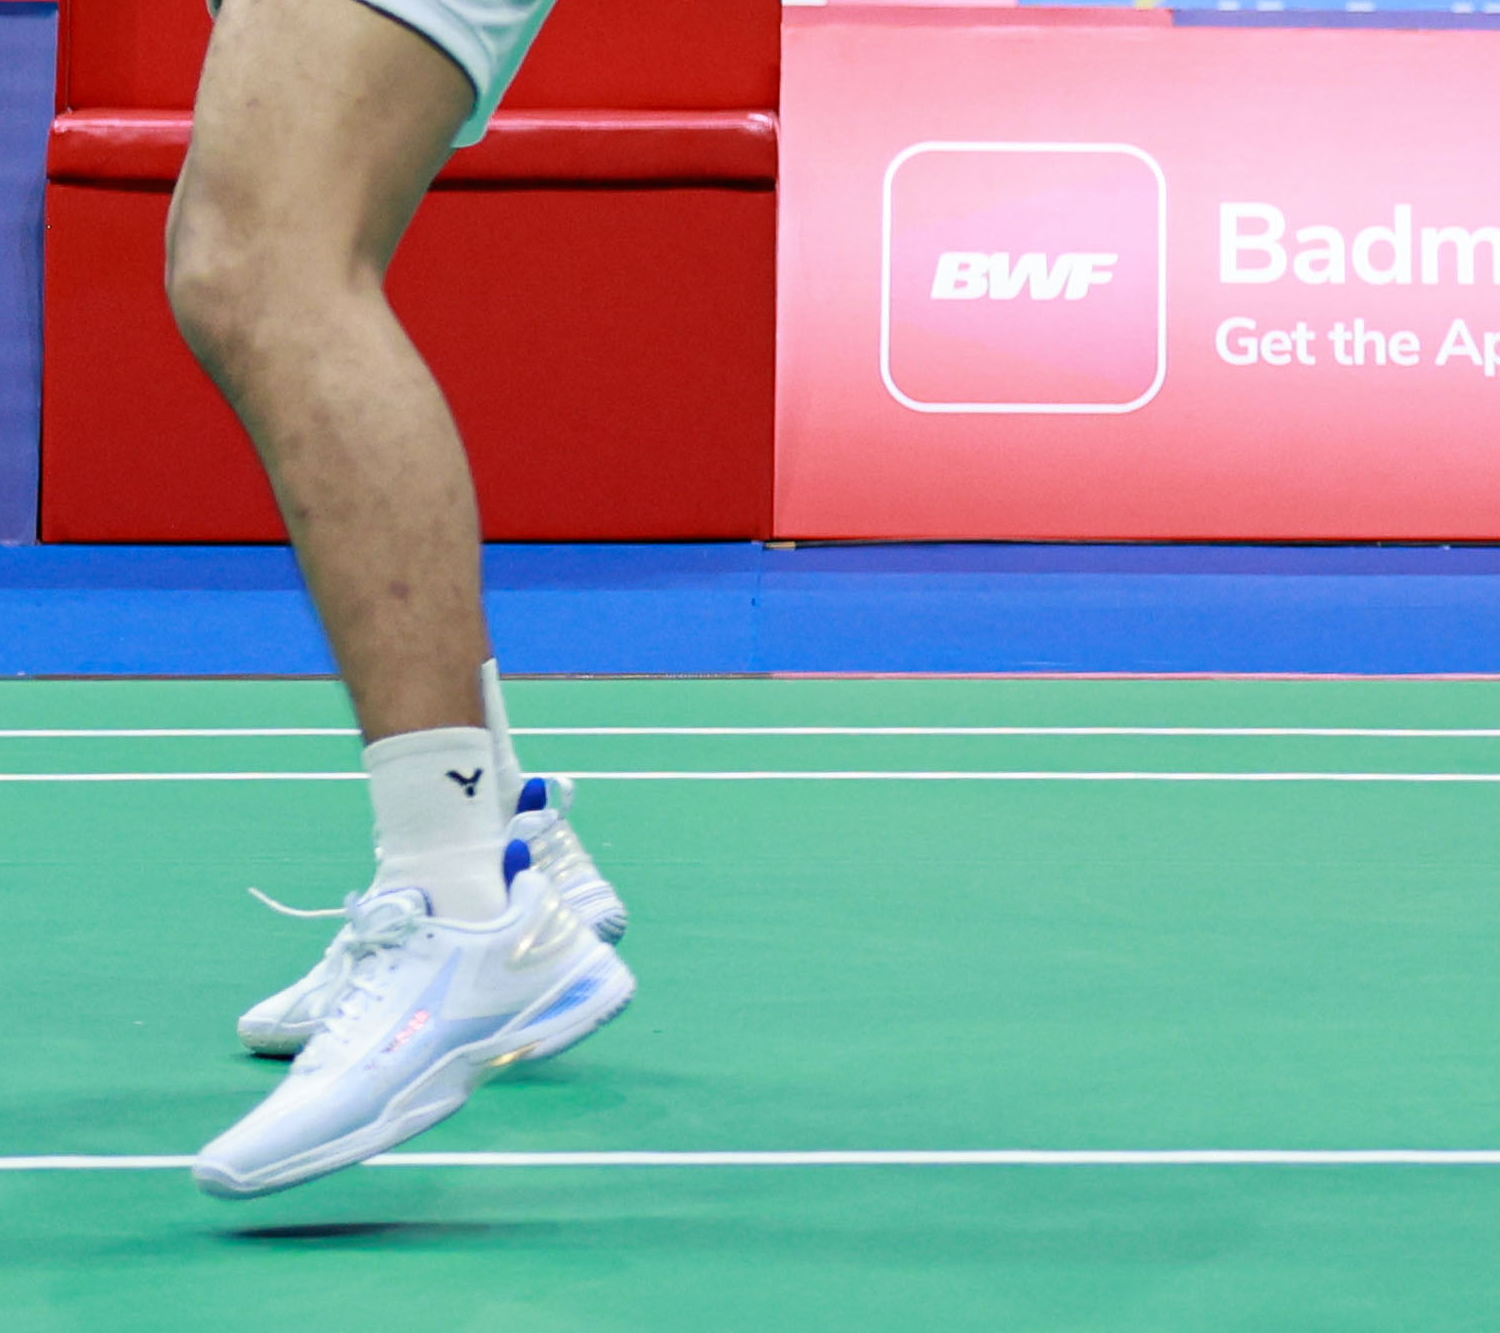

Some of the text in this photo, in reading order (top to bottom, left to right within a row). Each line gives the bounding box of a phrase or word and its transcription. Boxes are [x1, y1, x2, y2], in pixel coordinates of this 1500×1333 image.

[930, 250, 1119, 301] BWF
[1214, 316, 1317, 367] Get
[1328, 317, 1422, 367] the
